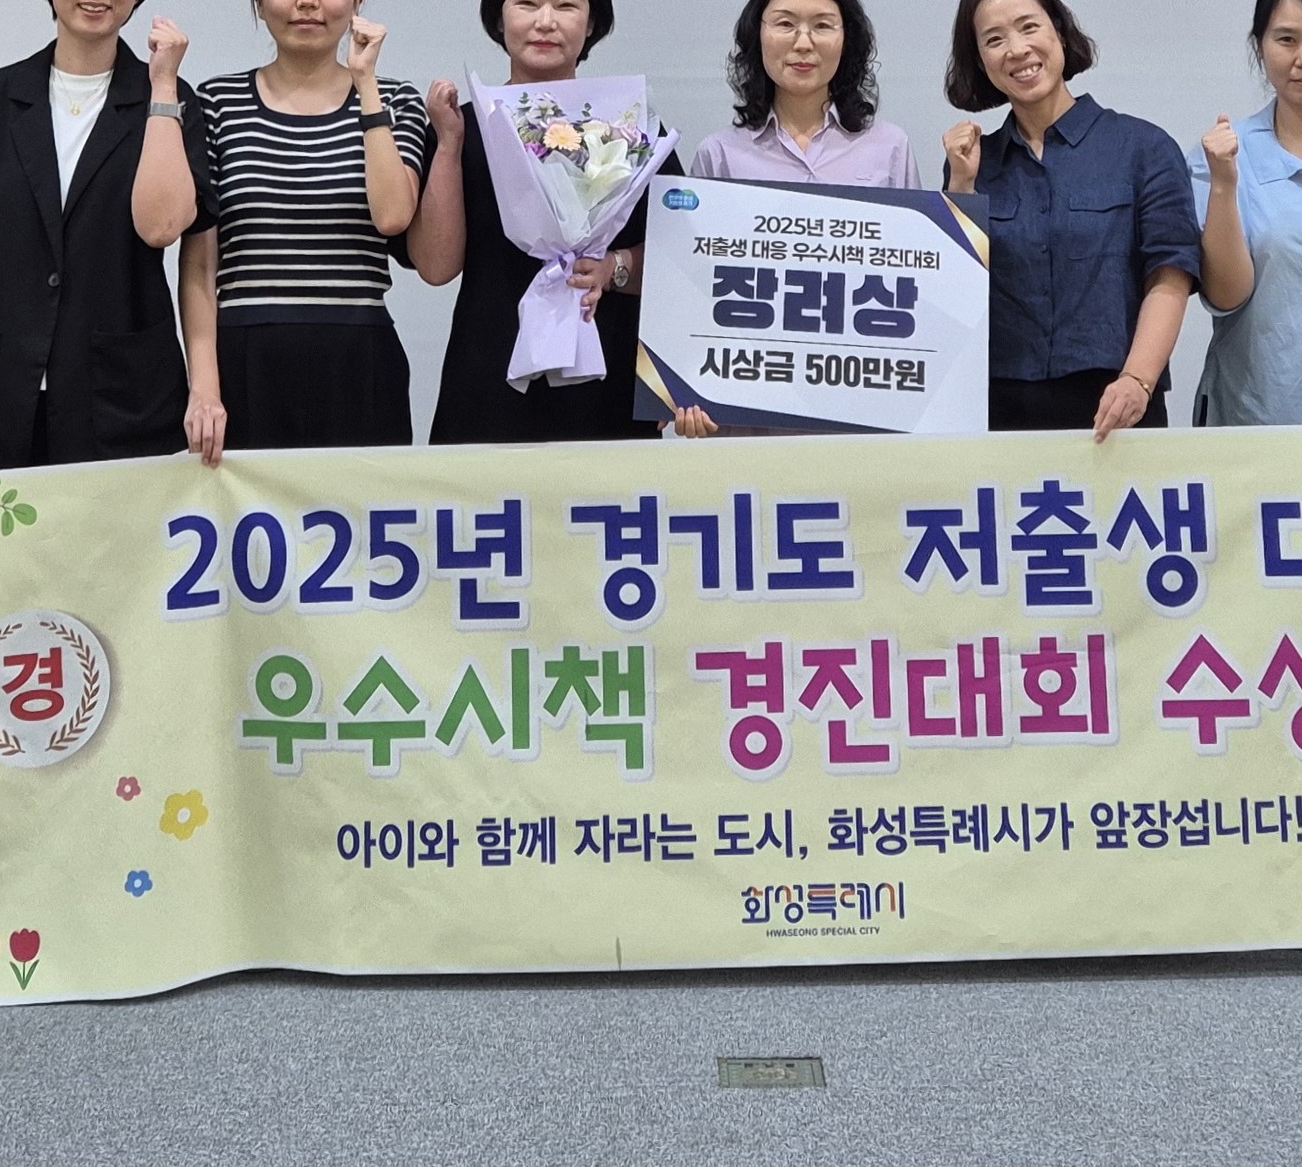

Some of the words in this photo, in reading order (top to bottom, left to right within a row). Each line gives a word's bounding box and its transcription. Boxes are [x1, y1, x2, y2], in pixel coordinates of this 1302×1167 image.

[693, 237, 747, 257] 저출생
[752, 240, 787, 260] 대응
[792, 242, 864, 264] 우수시책
[869, 248, 939, 270] 경진대회
[753, 215, 824, 238] 2025년
[829, 220, 881, 240] 경기도
[711, 265, 919, 339] 장려상
[699, 347, 795, 384] 시상금
[805, 353, 926, 392] 500만원
[168, 500, 521, 619] 2025년
[572, 494, 853, 620] 경기도
[906, 481, 1206, 606] 저출생
[3, 648, 64, 721] 경
[244, 647, 645, 768] 우수시책
[696, 635, 1108, 769] 경진대회
[337, 820, 459, 868] 아이와
[475, 816, 558, 867] 함께
[574, 814, 696, 862] 자라는
[714, 810, 807, 860] 도시,
[828, 803, 1074, 855] 화성특례시가
[765, 927, 819, 938] HWASEONG
[820, 927, 857, 937] SPECIAL
[859, 926, 881, 936] CITY
